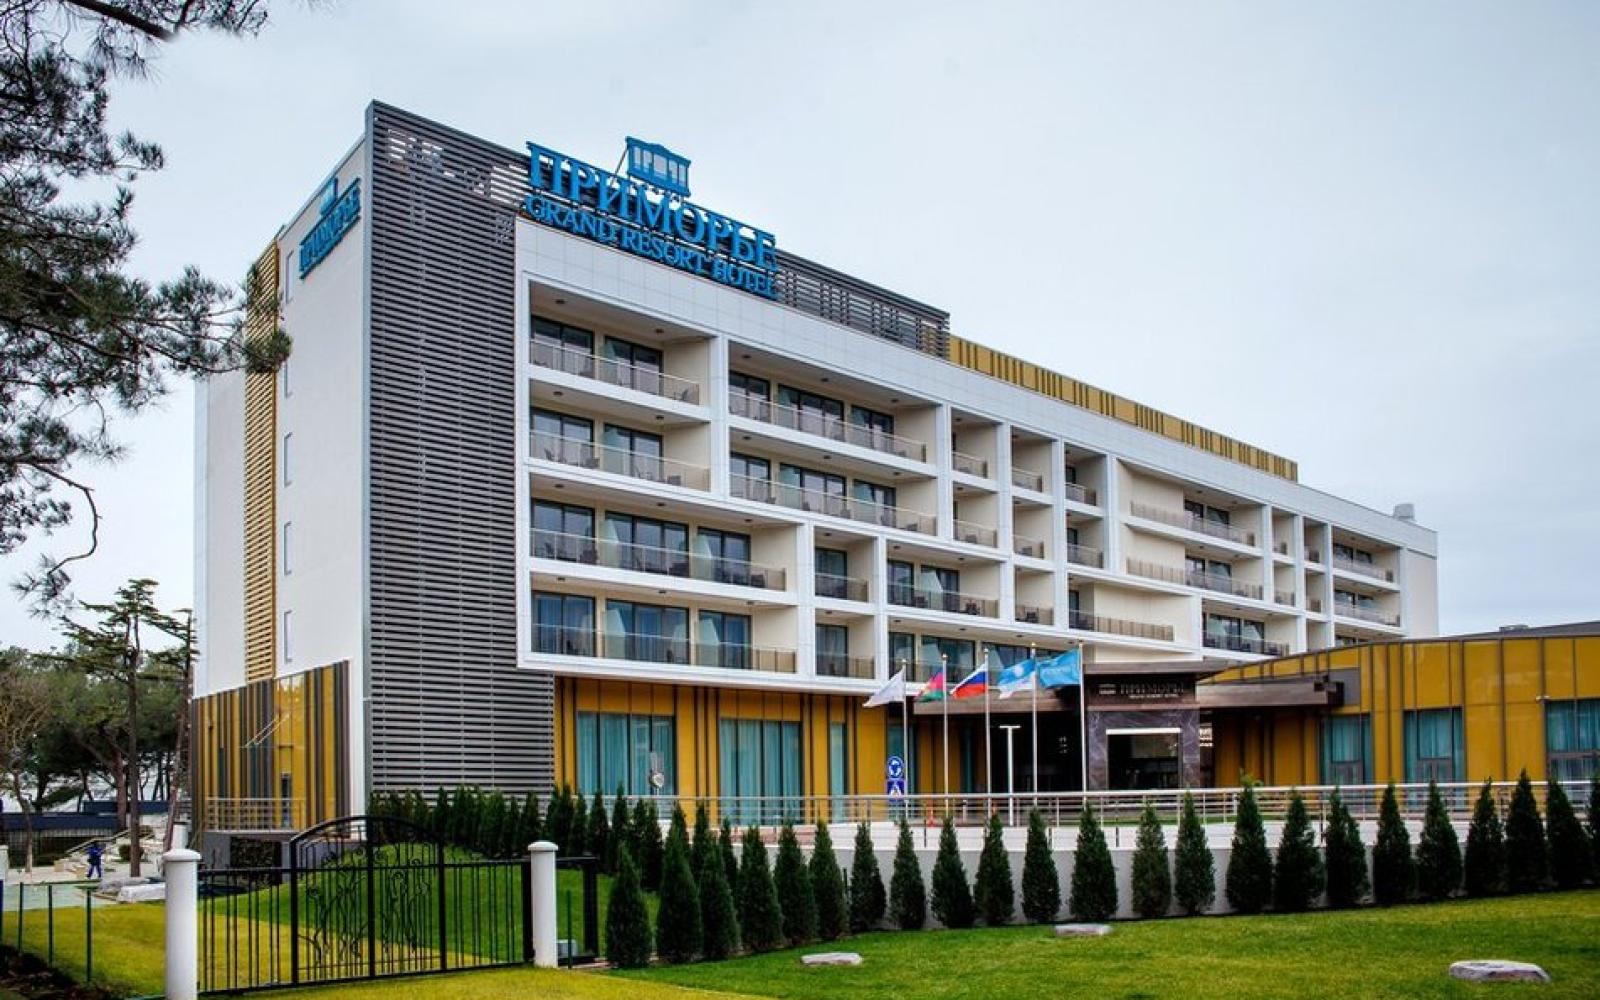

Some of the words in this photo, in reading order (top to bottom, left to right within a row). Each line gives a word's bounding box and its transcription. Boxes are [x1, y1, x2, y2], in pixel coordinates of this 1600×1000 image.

[525, 141, 777, 274] ПРИМОРЬЕ
[525, 193, 618, 243] GRAND
[621, 227, 710, 275] RESORT
[712, 257, 778, 299] HOTEL
